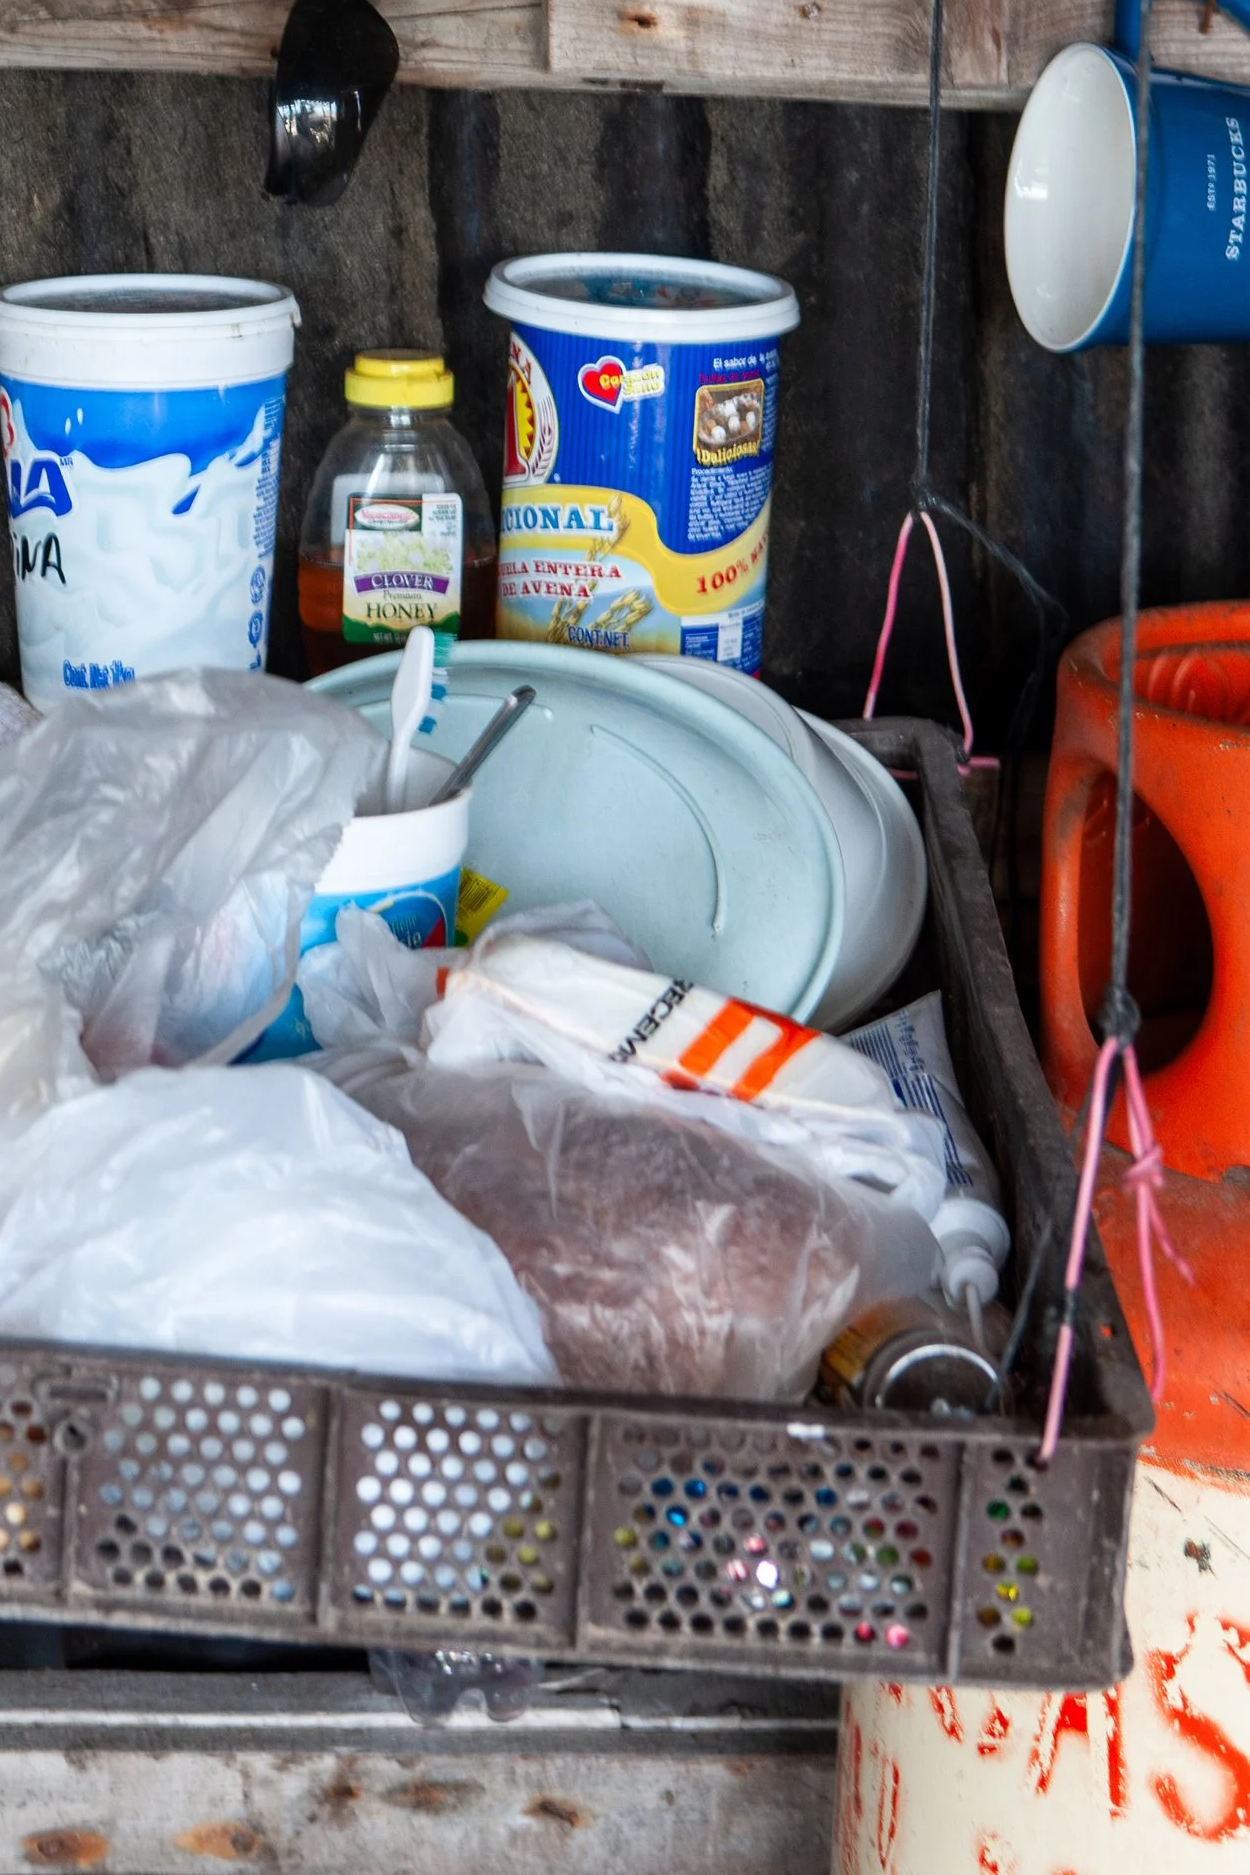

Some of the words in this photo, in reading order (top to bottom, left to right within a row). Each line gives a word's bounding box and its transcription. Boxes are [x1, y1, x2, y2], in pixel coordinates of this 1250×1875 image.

[1206, 153, 1216, 181] 1971
[1225, 116, 1248, 261] STARBUCKS
[533, 559, 623, 579] ENTERA
[697, 557, 750, 595] 100%
[370, 573, 434, 591] CLOVER
[502, 581, 517, 597] DE
[521, 579, 591, 599] AVENA
[382, 589, 423, 601] Premium
[366, 601, 438, 620] HONEY
